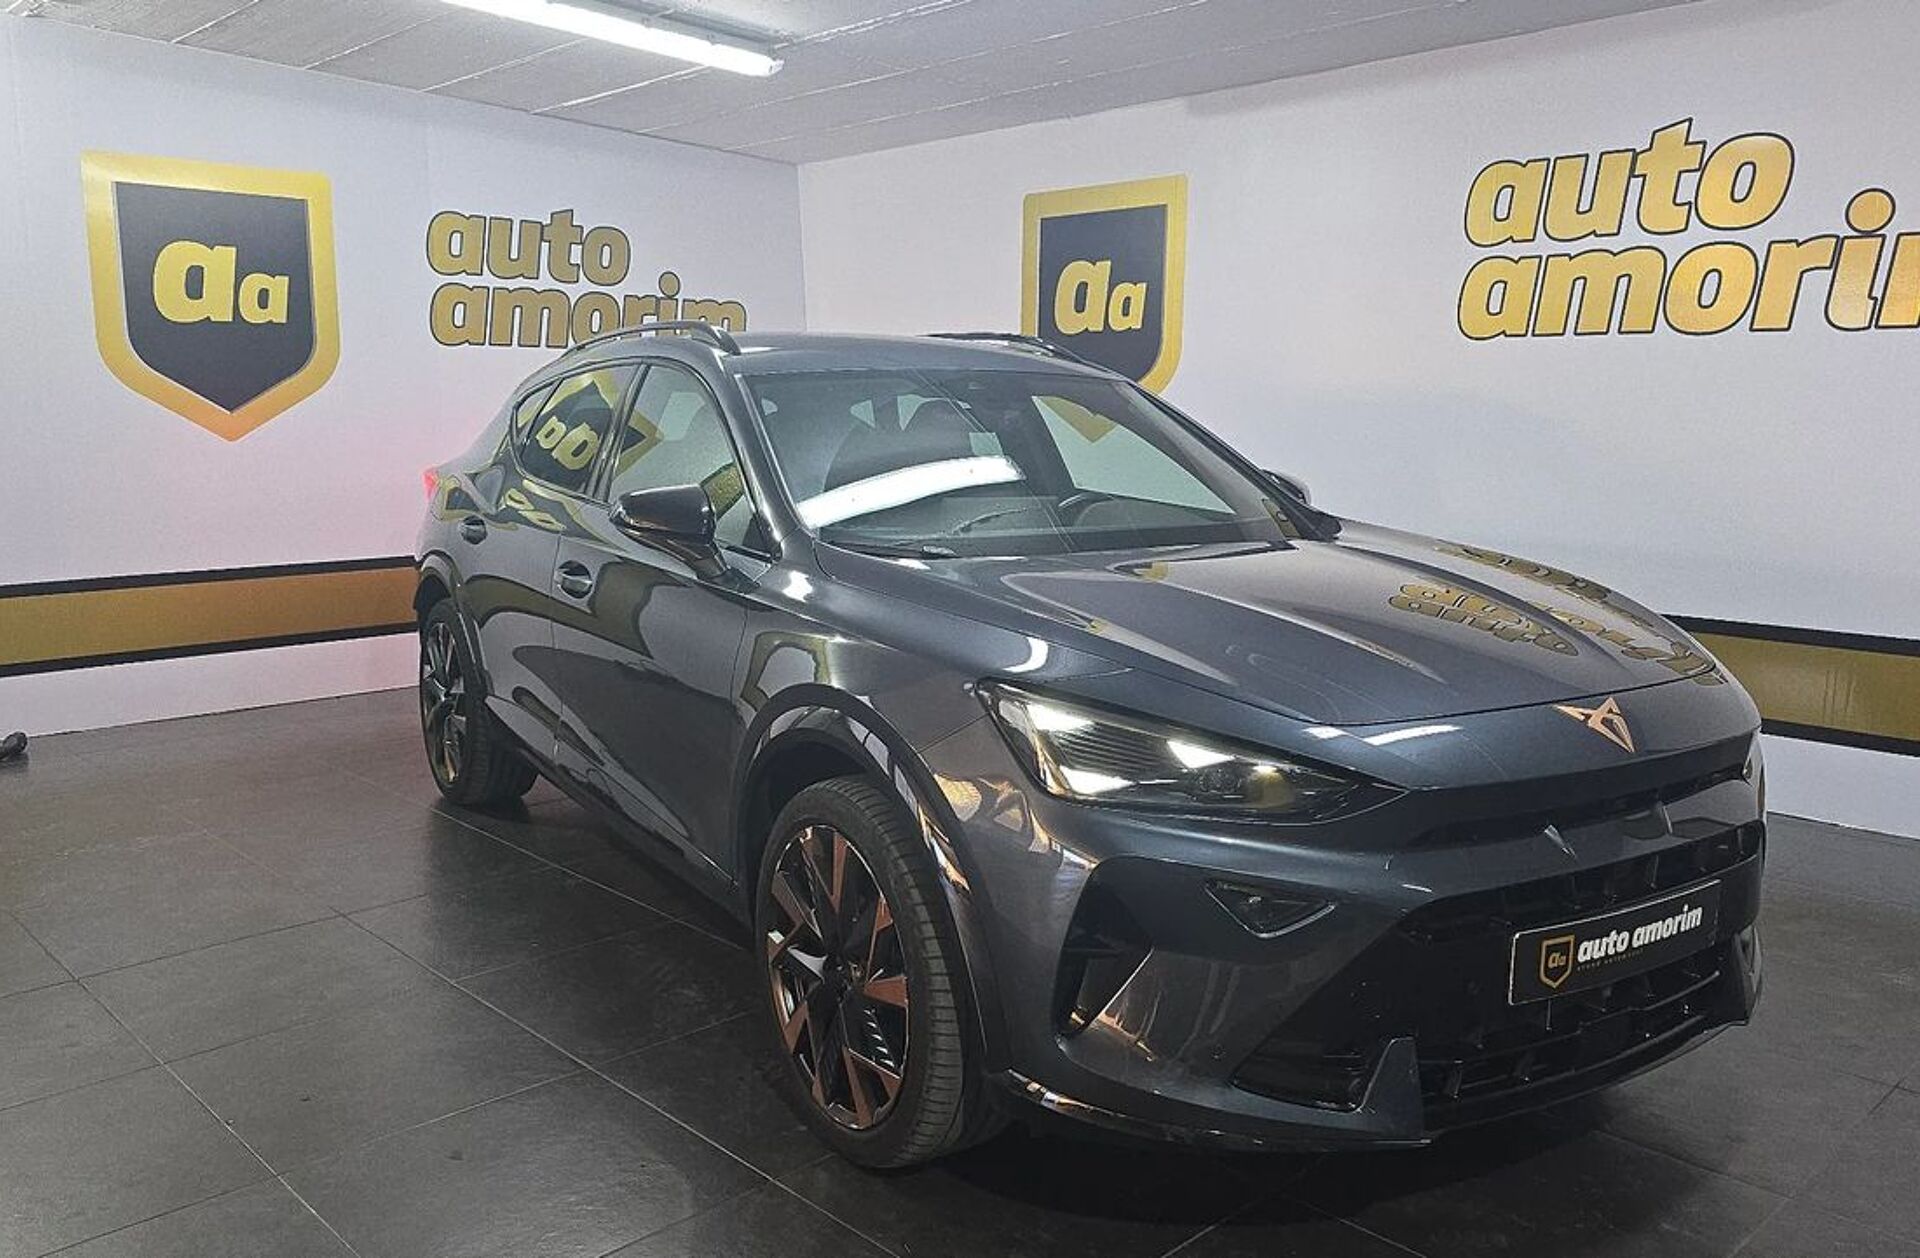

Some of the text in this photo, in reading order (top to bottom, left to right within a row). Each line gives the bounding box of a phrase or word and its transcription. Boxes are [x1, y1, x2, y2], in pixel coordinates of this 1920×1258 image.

[1464, 116, 1795, 248] auto
[152, 239, 289, 324] aa
[426, 209, 631, 286] auto
[429, 270, 747, 348] amorim
[1054, 259, 1148, 335] aa
[1576, 929, 1630, 963] auto
[1632, 904, 1703, 948] amorim
